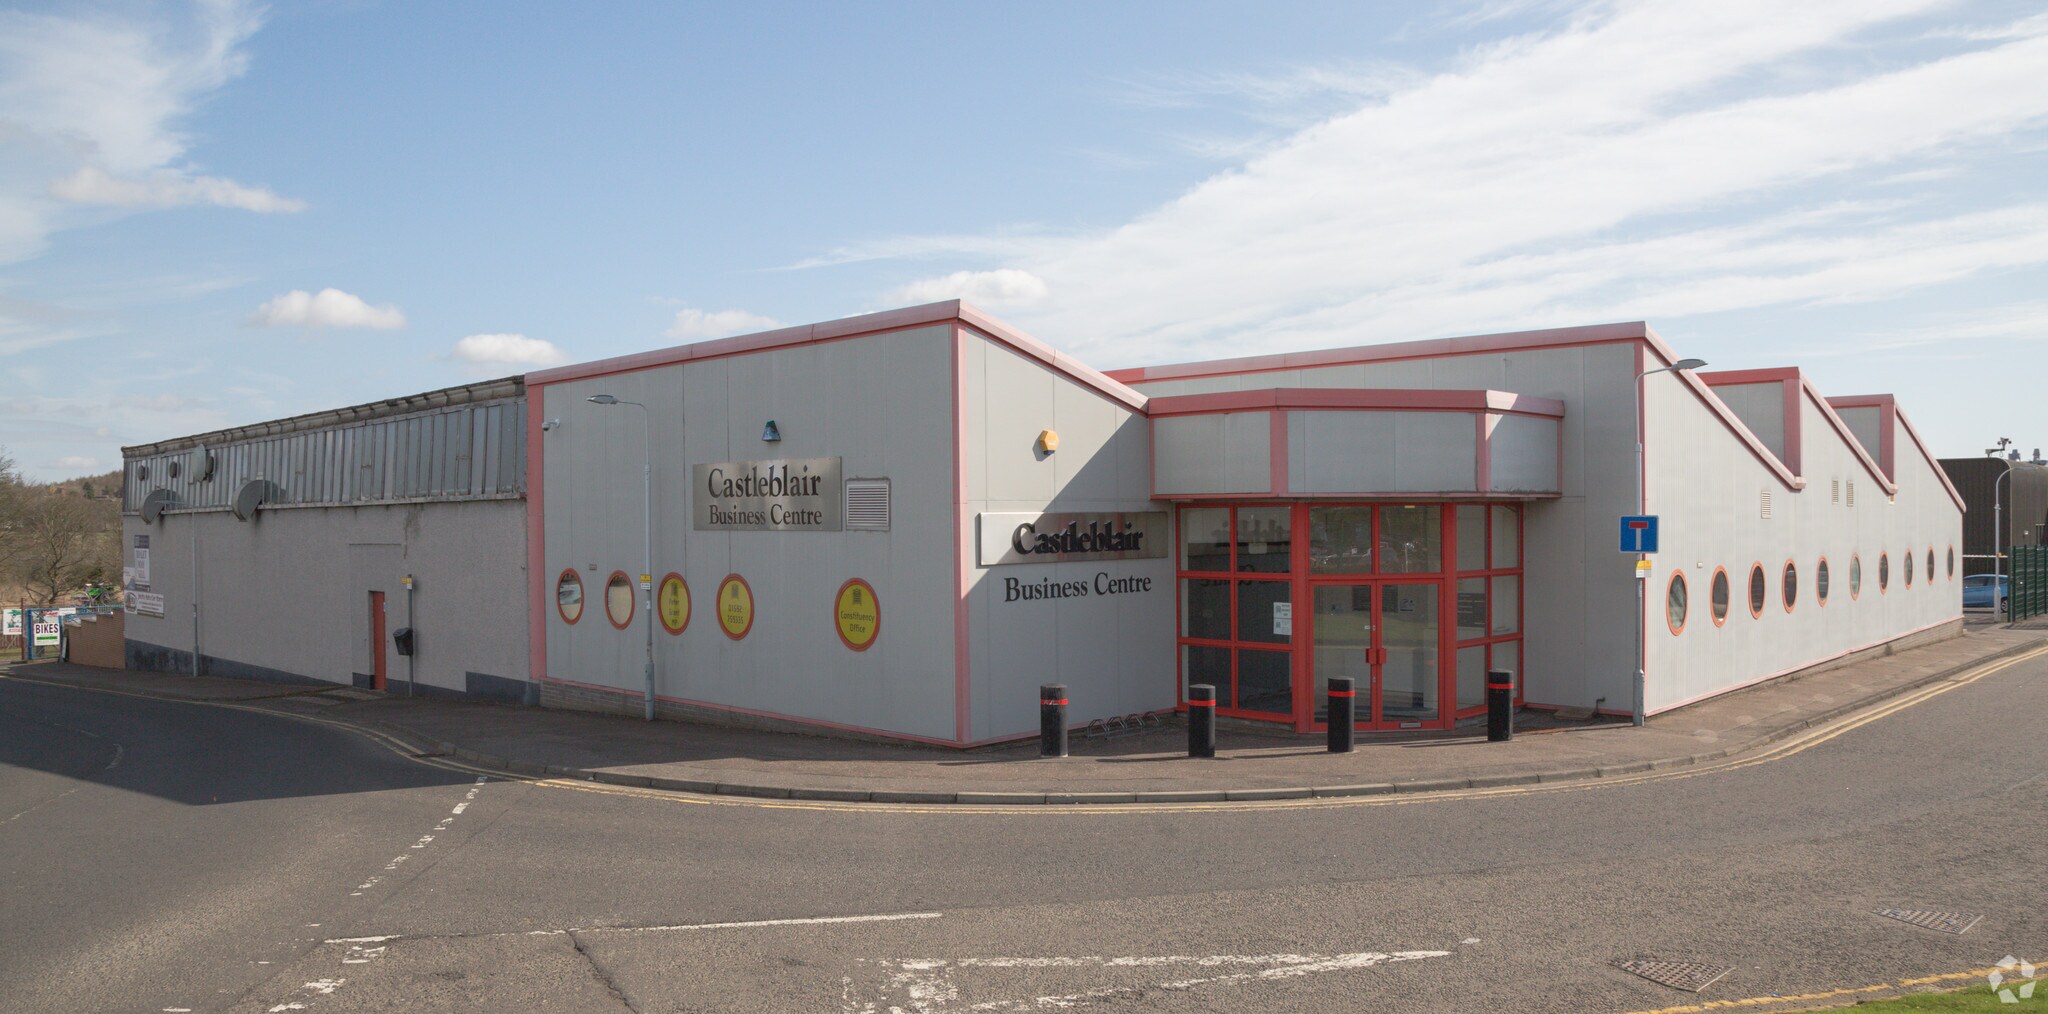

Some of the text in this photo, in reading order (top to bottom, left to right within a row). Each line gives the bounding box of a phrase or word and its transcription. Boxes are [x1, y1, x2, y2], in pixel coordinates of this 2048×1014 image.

[708, 464, 821, 498] Castleblair
[709, 503, 822, 525] Business Centre
[1011, 520, 1143, 555] Castleblair
[1004, 571, 1151, 602] Business Centre
[840, 610, 875, 623] Constituency
[35, 623, 59, 634] BIKES
[849, 623, 866, 633] Office
